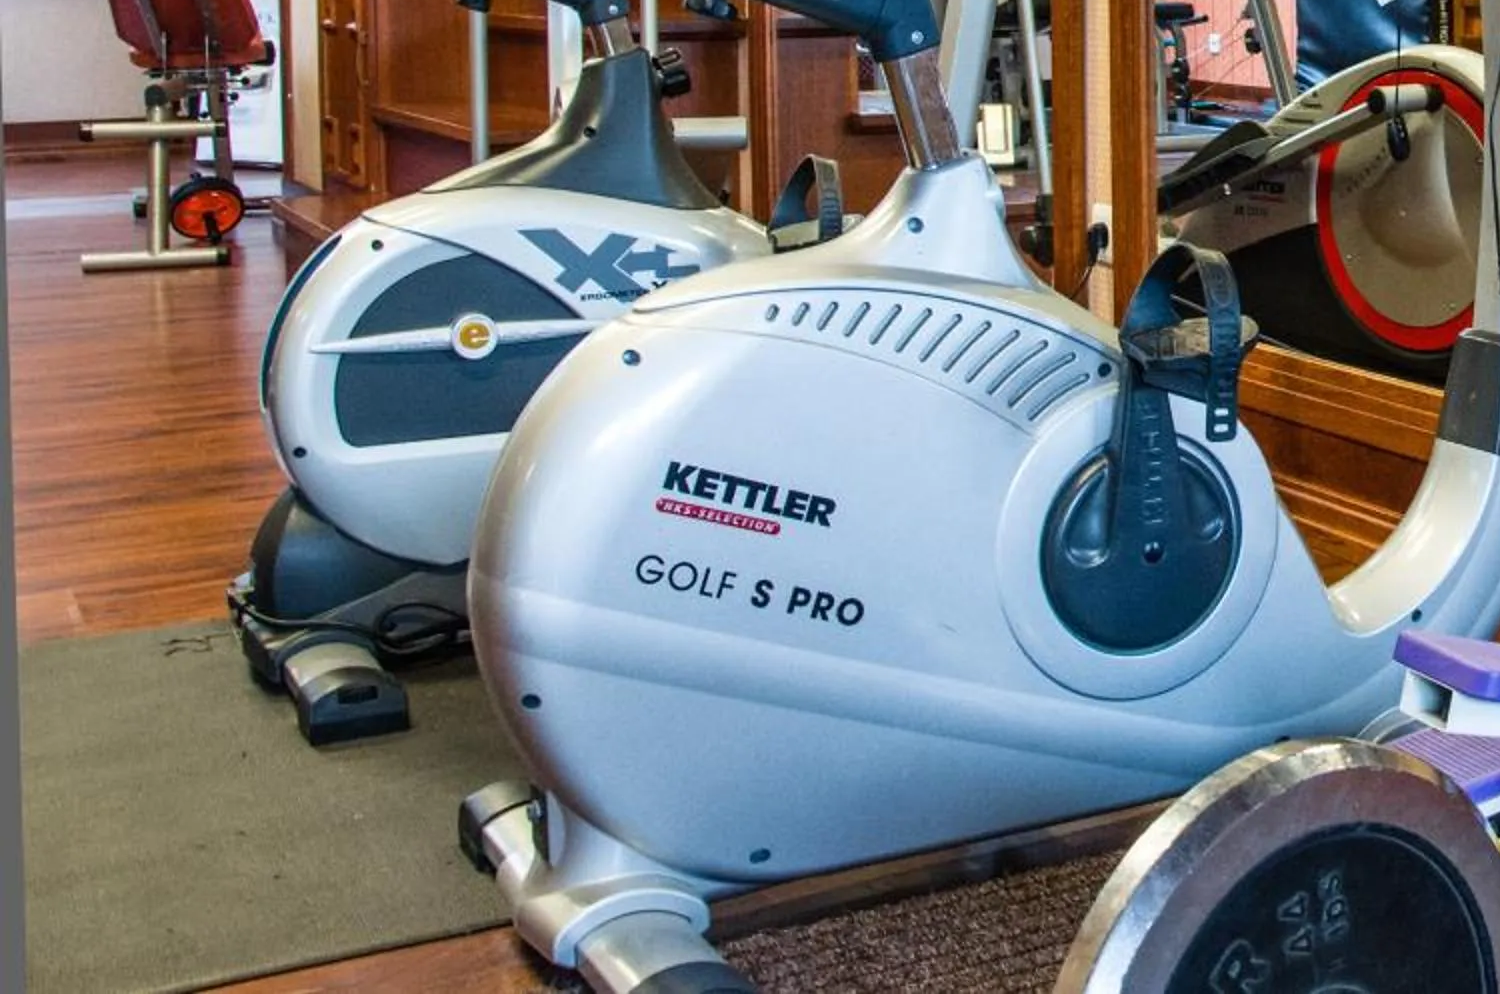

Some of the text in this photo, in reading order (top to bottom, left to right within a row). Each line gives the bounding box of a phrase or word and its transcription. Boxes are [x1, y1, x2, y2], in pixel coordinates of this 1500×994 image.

[663, 461, 837, 527] KETTLER
[635, 554, 865, 627] GOLF S PRO
